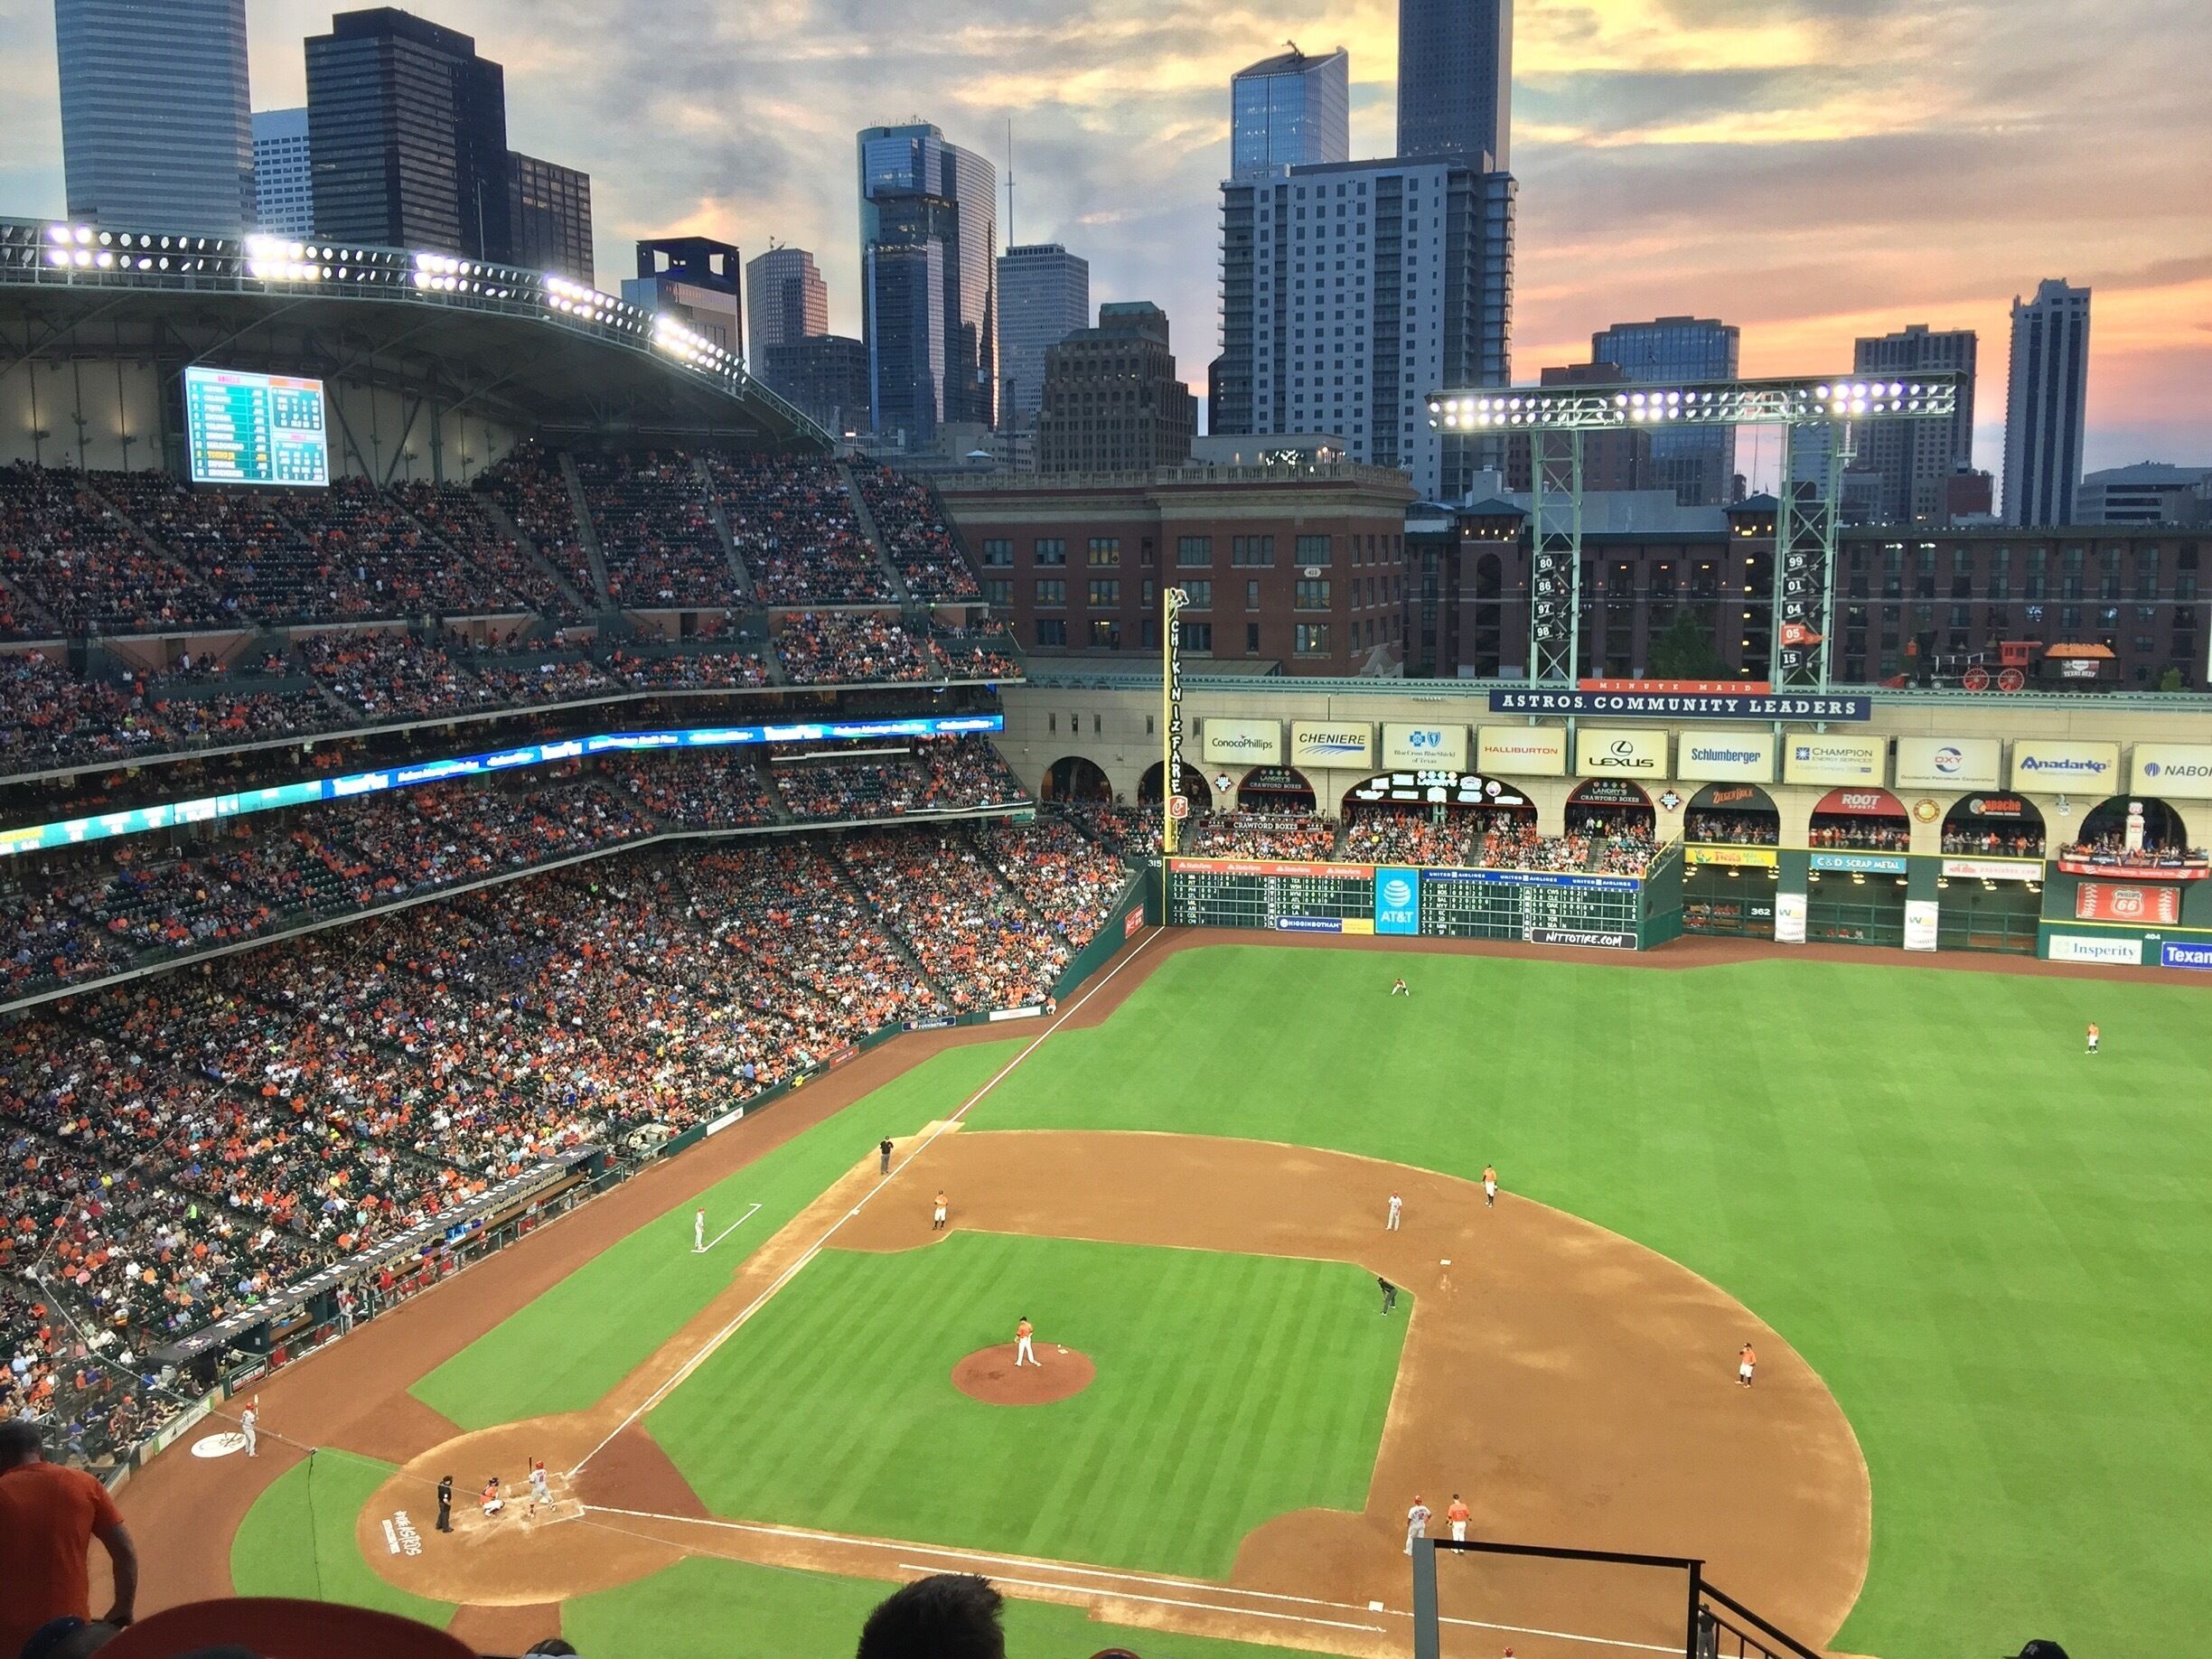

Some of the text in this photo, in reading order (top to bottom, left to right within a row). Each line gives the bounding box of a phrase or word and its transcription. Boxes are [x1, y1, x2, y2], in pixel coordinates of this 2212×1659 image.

[1540, 558, 1552, 568] 80
[1789, 557, 1803, 567] 99
[1539, 582, 1551, 591] 86
[1788, 581, 1801, 590] 01
[1538, 605, 1550, 614] 97
[1787, 605, 1801, 614] 04
[1537, 627, 1549, 636] 98
[1786, 629, 1800, 639] 05
[1171, 621, 1181, 701] CHIKIN
[1784, 654, 1796, 663] 15
[1599, 682, 1679, 690] MINUTE
[1594, 697, 1739, 712] COMMUNITY
[1749, 700, 1856, 715] LEADERS
[1213, 737, 1272, 750] ConocoPhillips
[1299, 734, 1365, 745] CHENIERE
[1692, 748, 1760, 764] Schlumberger
[1813, 748, 1872, 756] CHAMPION
[1589, 757, 1654, 767] LEXUS
[2020, 756, 2106, 773] Anadarko
[1842, 794, 1880, 804] ROOT
[1984, 799, 2021, 811] apache
[1846, 859, 1871, 867] SCRAP
[2117, 900, 2138, 911] 66
[1381, 911, 1413, 923] AT&T
[1546, 932, 1622, 947] NITTOTIRE.COM
[2074, 943, 2135, 960] Insperity
[2167, 947, 2212, 963] Texan
[215, 1163, 555, 1328] WELCOME TO MINUTE MAID PARK
